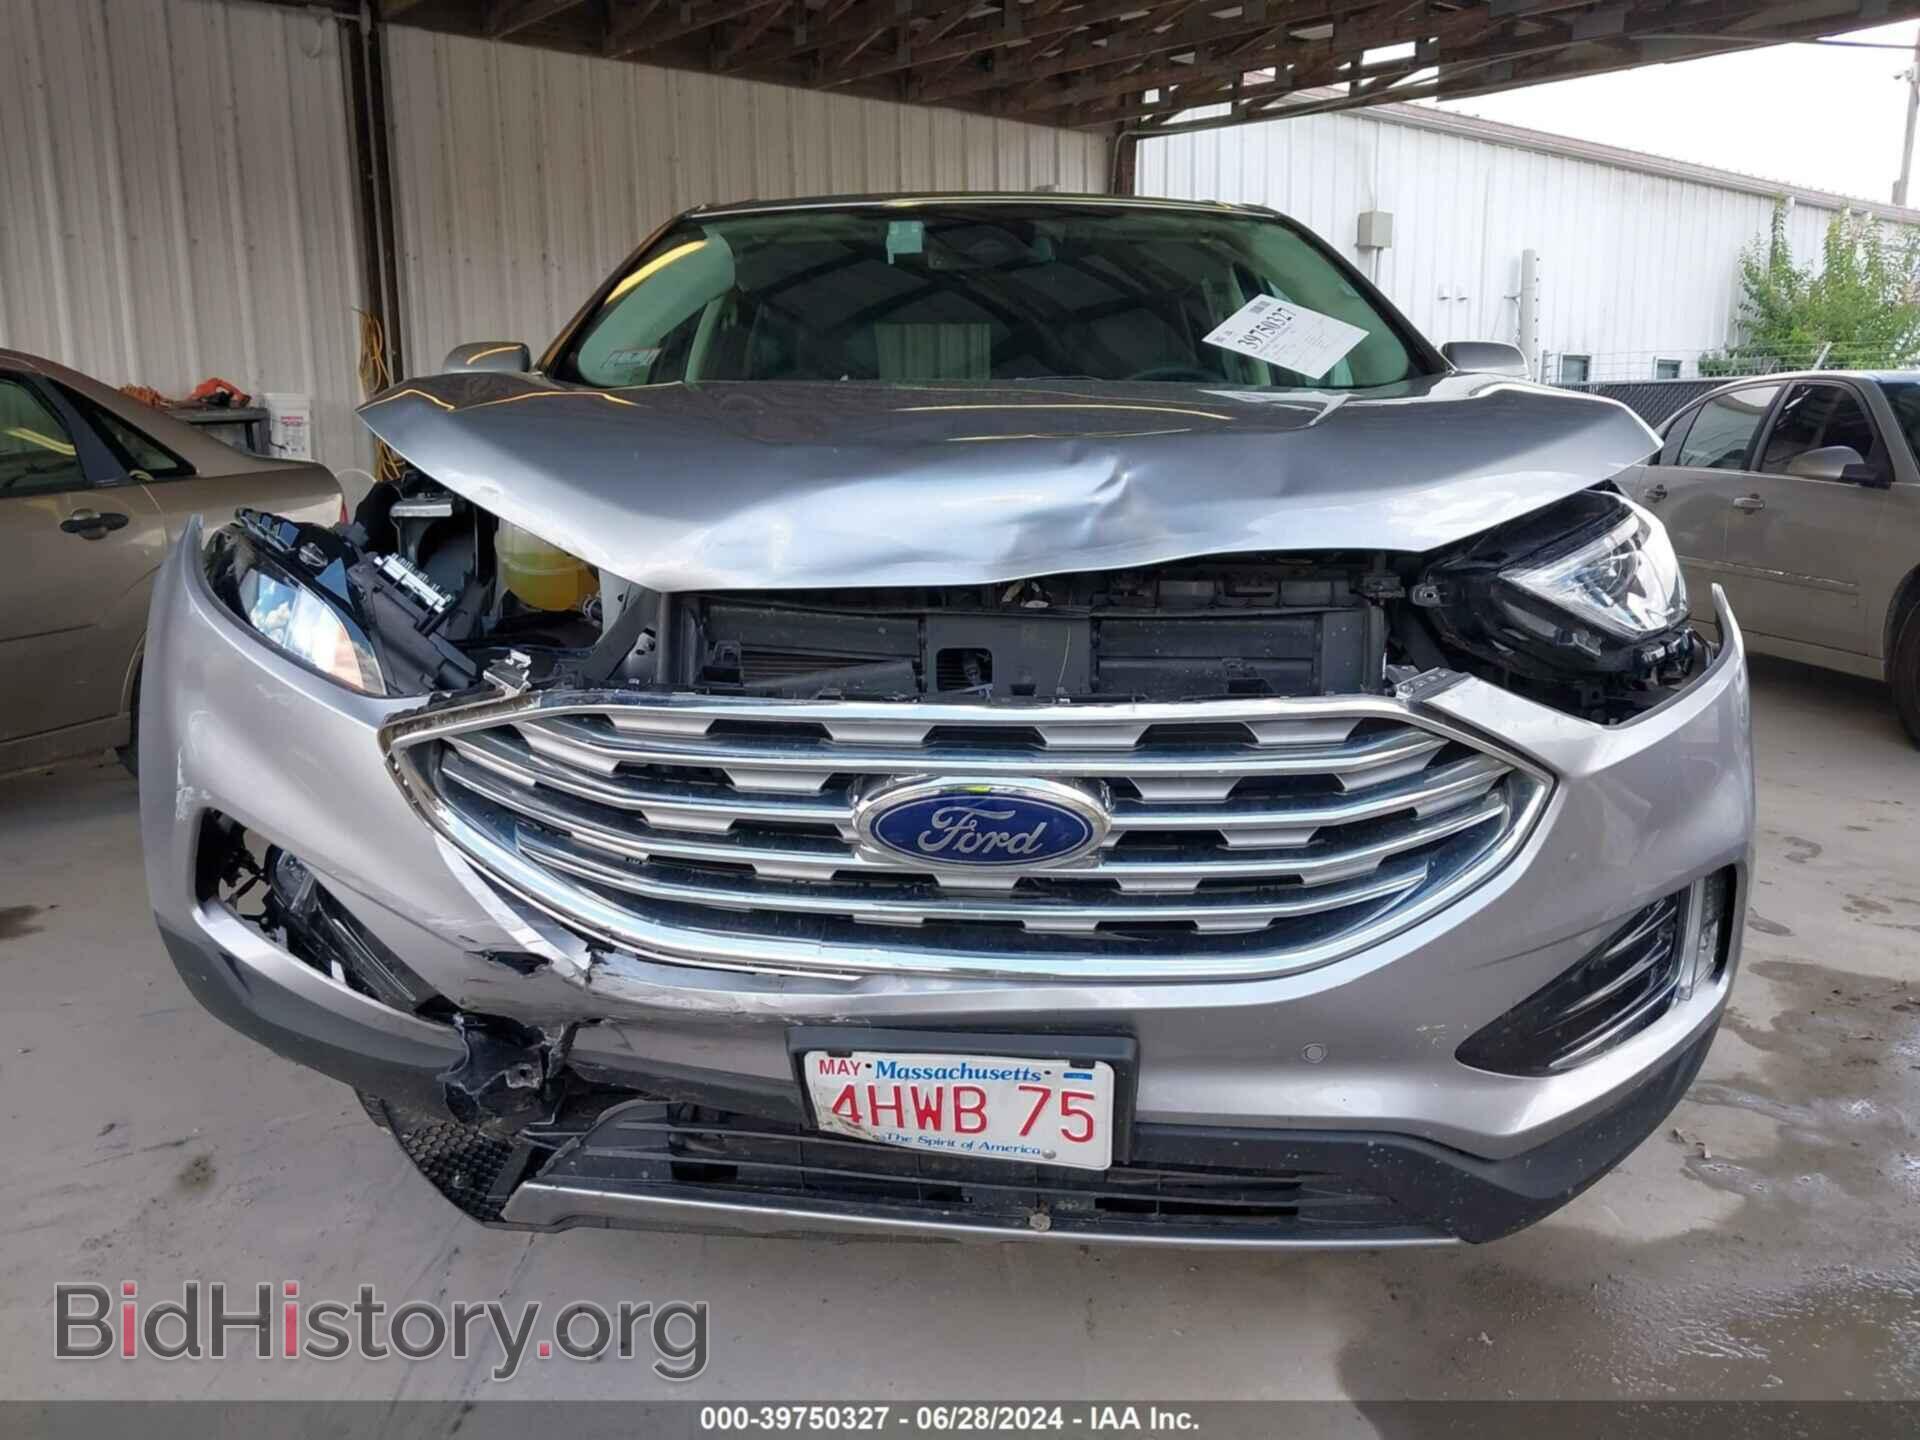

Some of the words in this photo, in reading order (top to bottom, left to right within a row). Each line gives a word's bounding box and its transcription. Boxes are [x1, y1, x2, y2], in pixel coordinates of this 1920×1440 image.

[1237, 306, 1297, 350] 39750327
[917, 806, 1048, 854] Ford
[820, 1059, 861, 1075] MAY
[876, 1061, 1042, 1082] Massachusetts
[831, 1084, 988, 1134] 4HWB
[1018, 1085, 1095, 1143] 75
[886, 1132, 913, 1142] The
[917, 1135, 956, 1148] Spirit
[961, 1140, 975, 1150] of
[979, 1141, 1041, 1155] America
